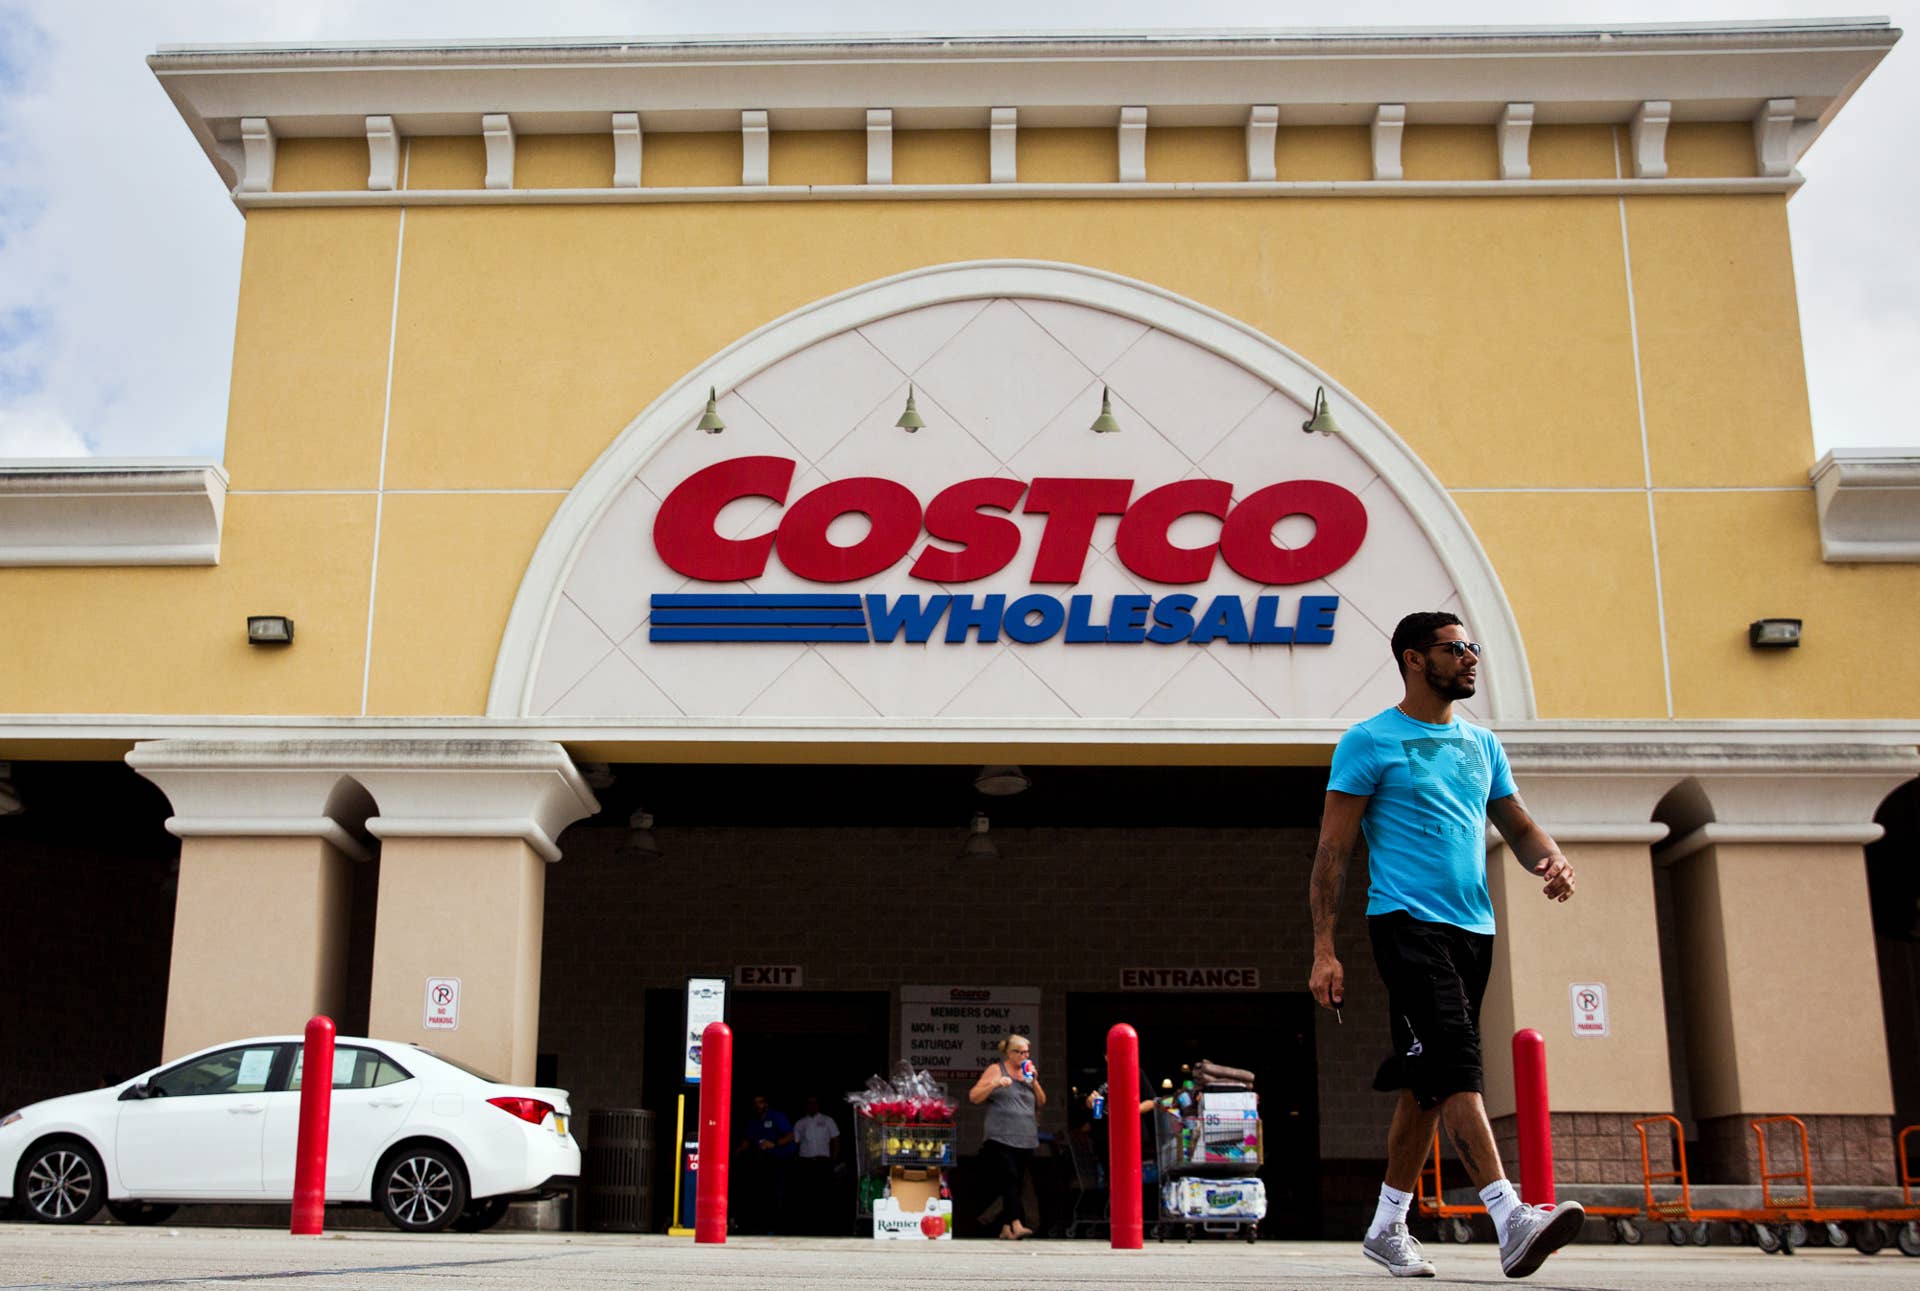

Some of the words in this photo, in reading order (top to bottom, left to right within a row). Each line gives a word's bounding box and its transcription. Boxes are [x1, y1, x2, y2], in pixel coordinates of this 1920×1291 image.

[652, 455, 1369, 584] COSTCO
[865, 593, 1340, 645] WHOLESALE
[741, 967, 796, 984] EXIT
[1123, 970, 1255, 986] ENTRANCE
[930, 1007, 981, 1017] MEMBERS
[984, 1008, 1010, 1018] ONLY
[911, 1023, 934, 1033] MON
[943, 1023, 960, 1033] FRI
[911, 1039, 963, 1050] SATURDAY
[911, 1056, 951, 1066] SUNDAY
[878, 1219, 919, 1232] Rainier
